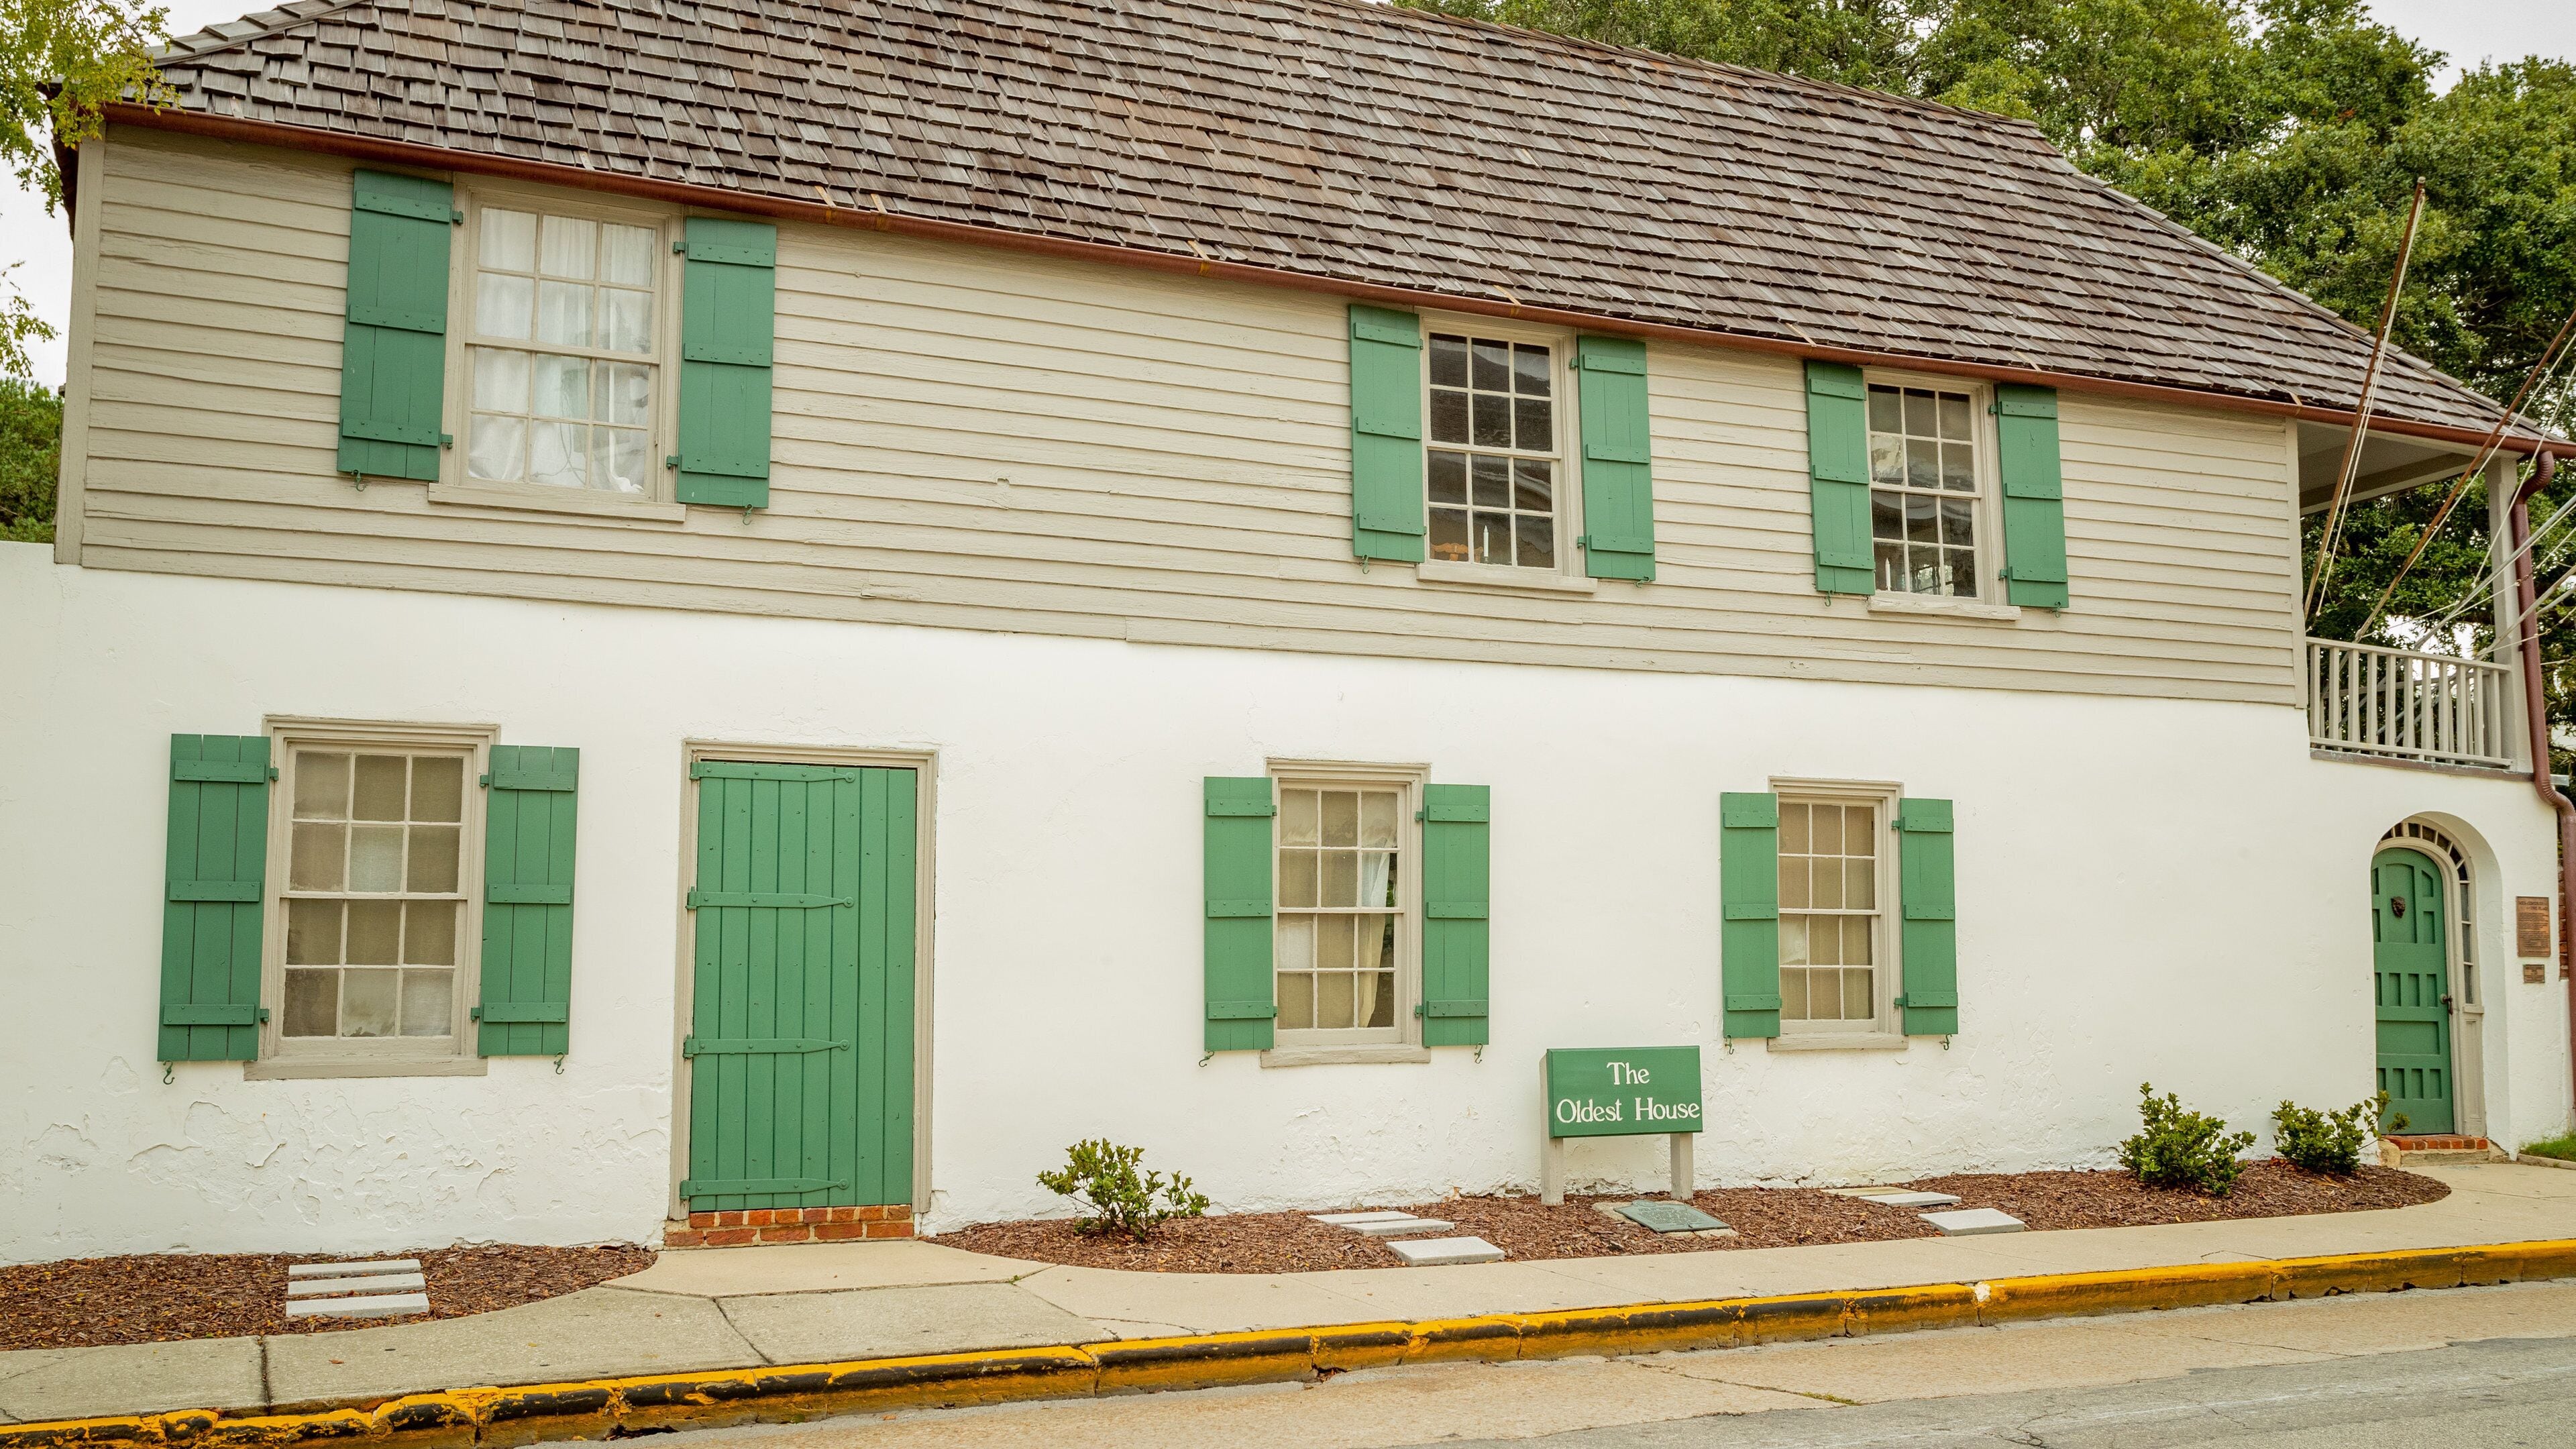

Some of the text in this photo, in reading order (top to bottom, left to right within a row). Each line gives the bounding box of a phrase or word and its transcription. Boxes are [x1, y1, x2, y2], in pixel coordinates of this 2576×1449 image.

[1606, 1062, 1650, 1085] The
[1556, 1097, 1700, 1123] Oldest House
